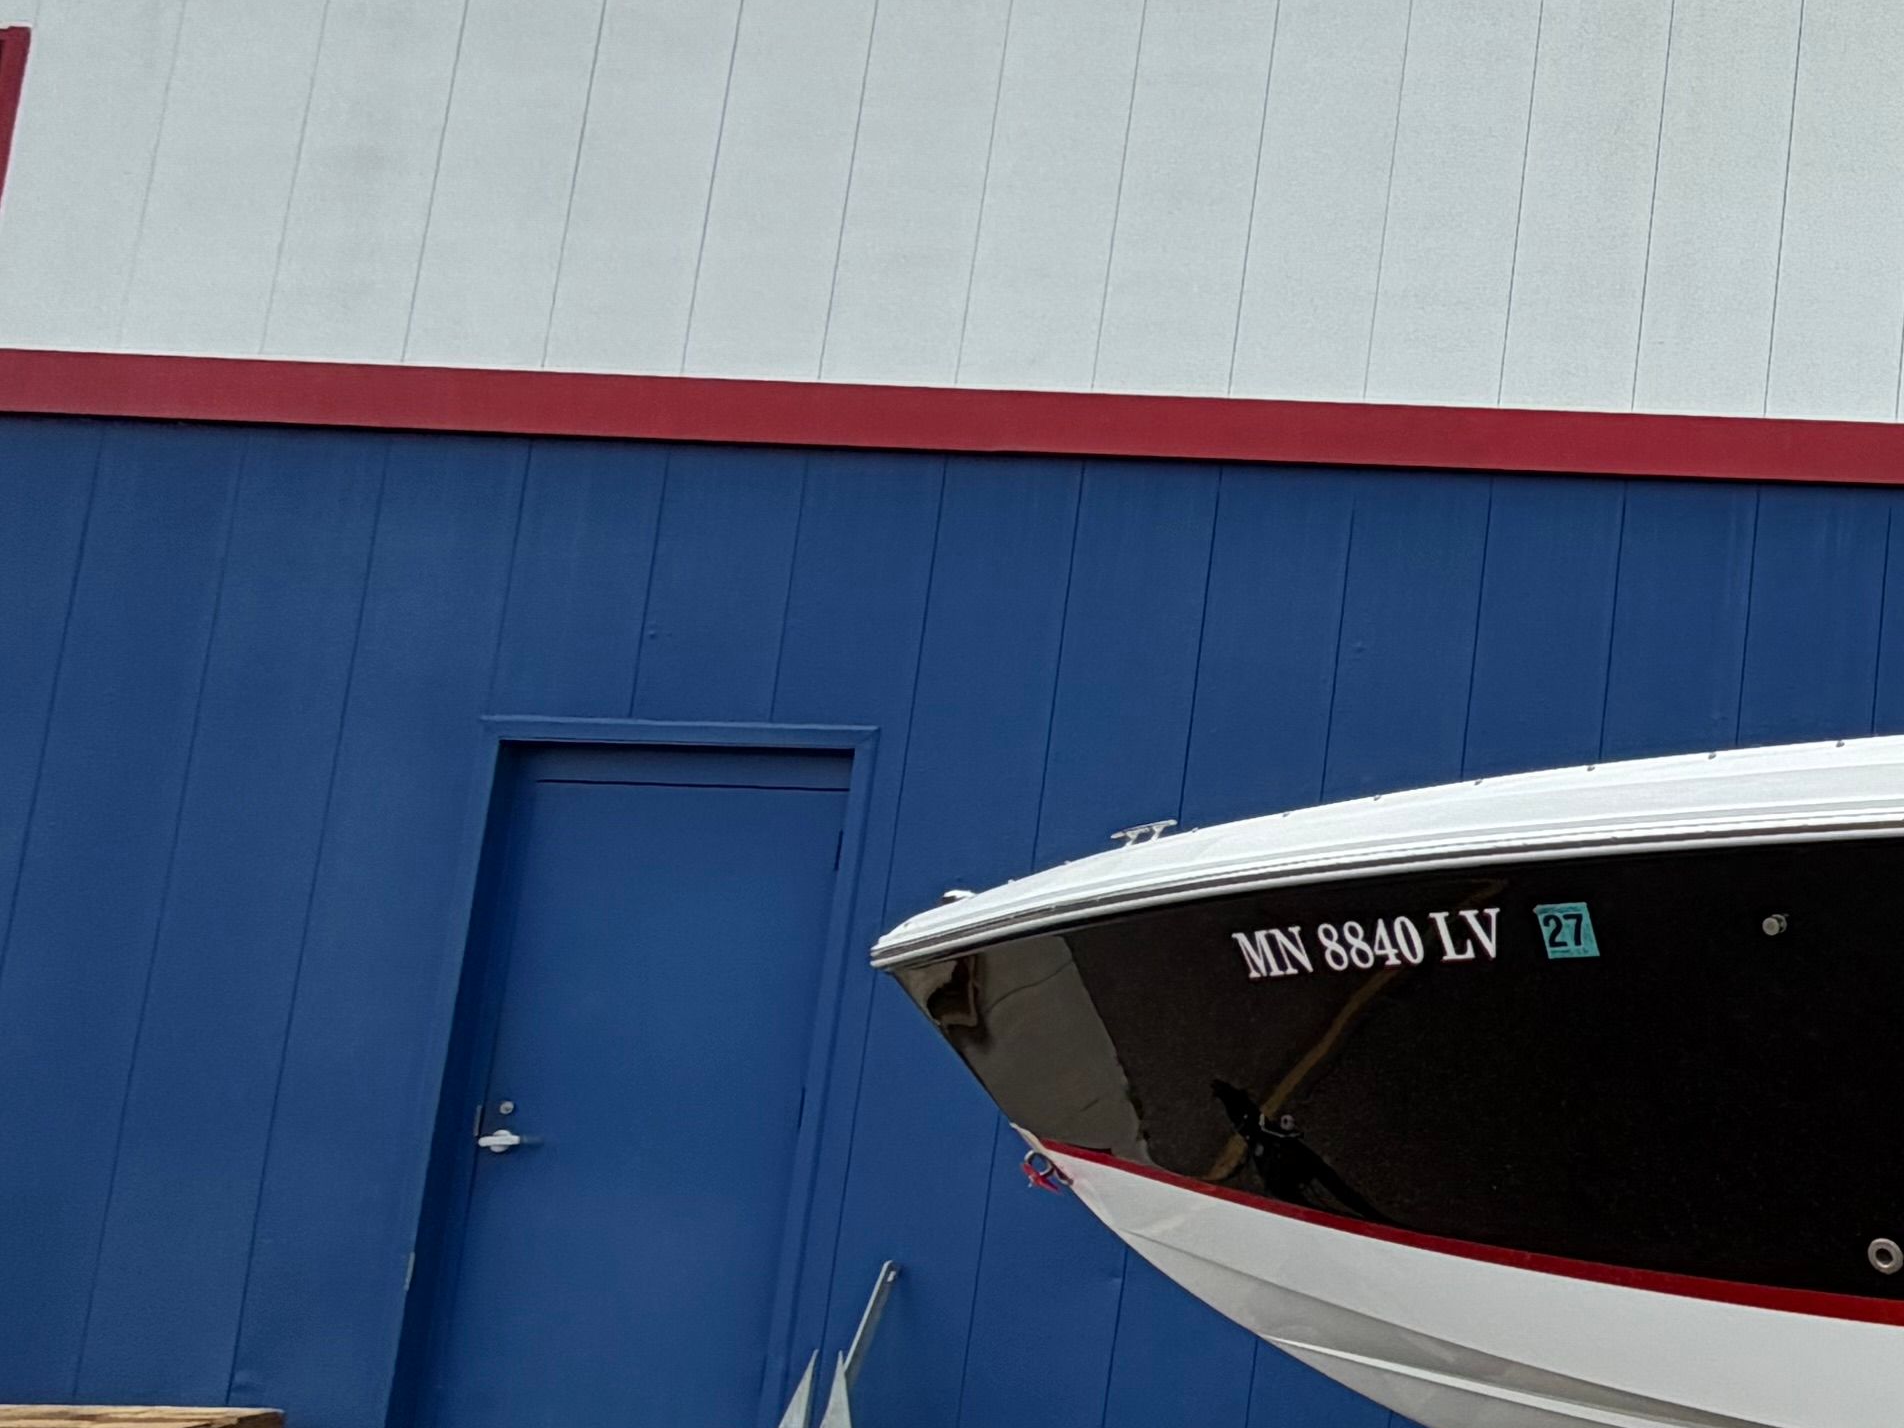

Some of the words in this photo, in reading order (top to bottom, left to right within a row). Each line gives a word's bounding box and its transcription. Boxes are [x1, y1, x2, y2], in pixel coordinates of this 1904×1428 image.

[1232, 925, 1314, 979] MN
[1318, 915, 1425, 971] 8840
[1429, 907, 1500, 961] LV
[1543, 913, 1583, 948] 27
